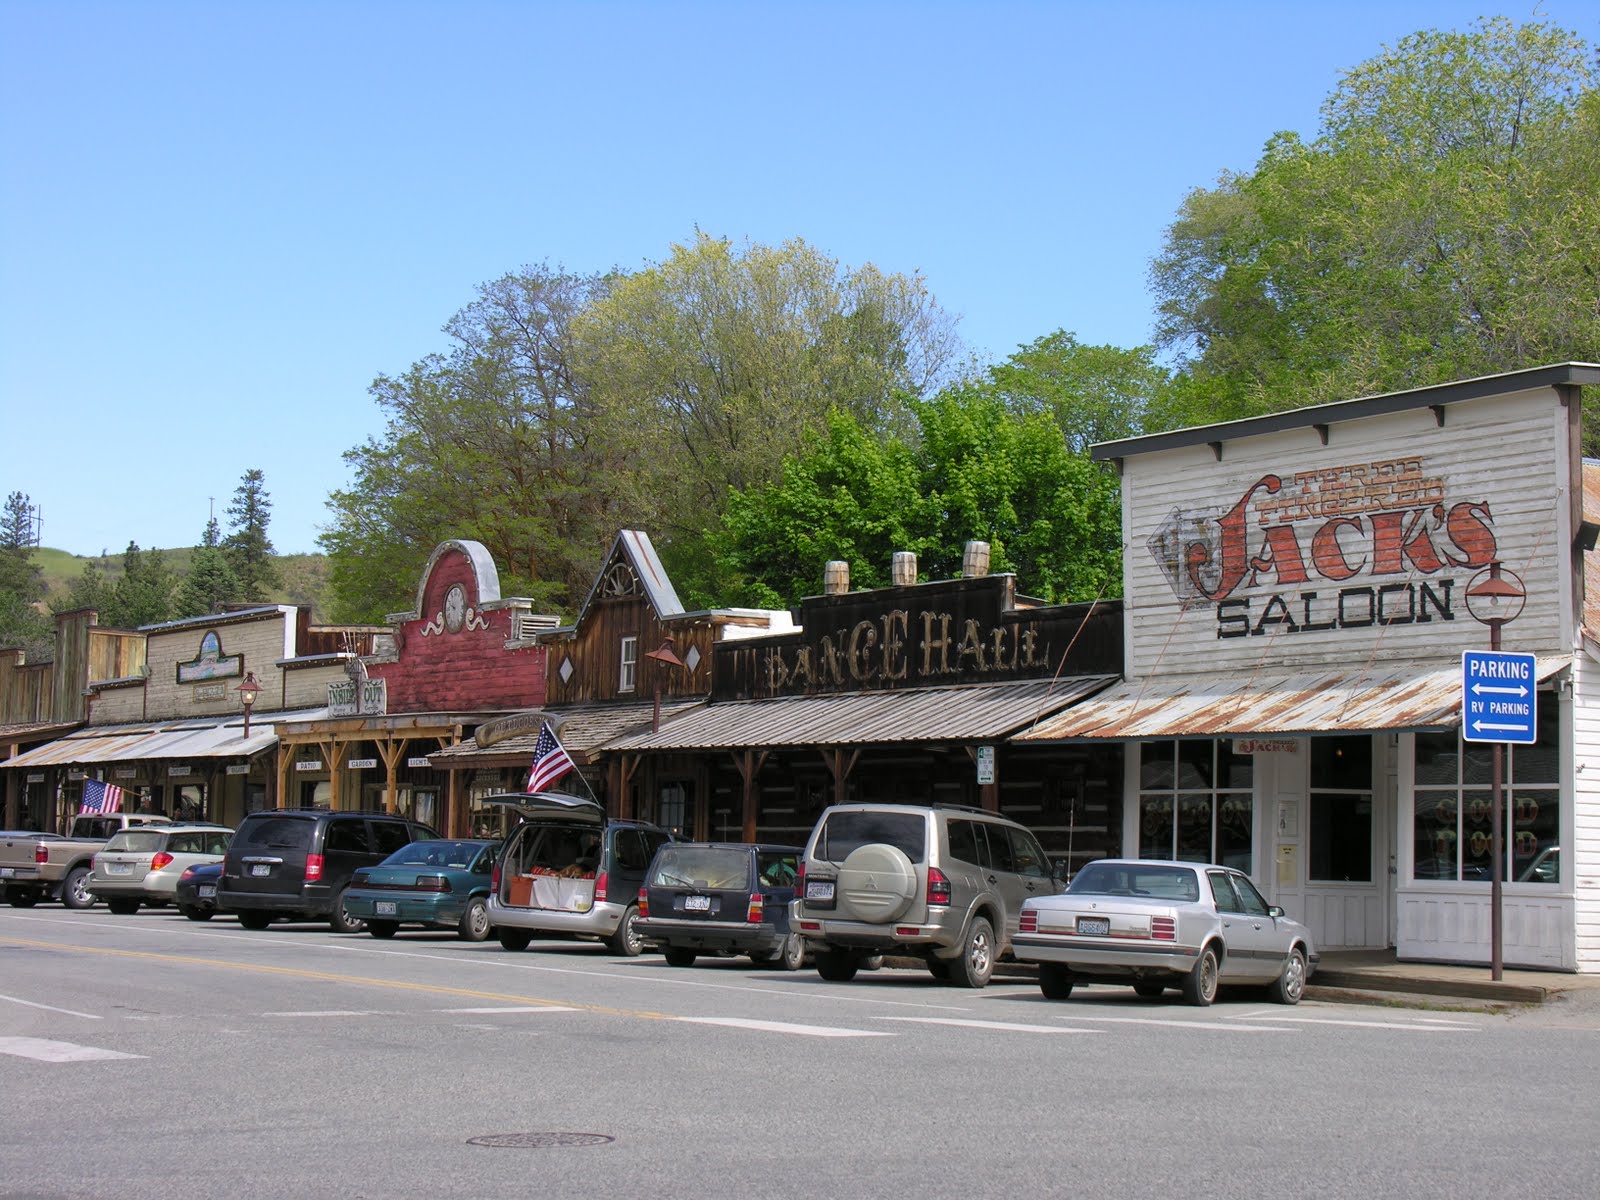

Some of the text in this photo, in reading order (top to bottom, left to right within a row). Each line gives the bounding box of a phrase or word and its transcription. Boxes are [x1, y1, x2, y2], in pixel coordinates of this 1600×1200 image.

[1295, 456, 1424, 494] THREE
[1255, 479, 1445, 525] FINGERED
[1186, 473, 1498, 600] JACK'S
[1217, 579, 1455, 640] SALOON
[764, 609, 908, 690] DANCE
[1470, 659, 1529, 680] PARKING
[363, 686, 383, 703] OUT
[1471, 701, 1530, 716] RV PARKING
[300, 762, 318, 770] PATIO
[351, 760, 373, 768] GARDEN
